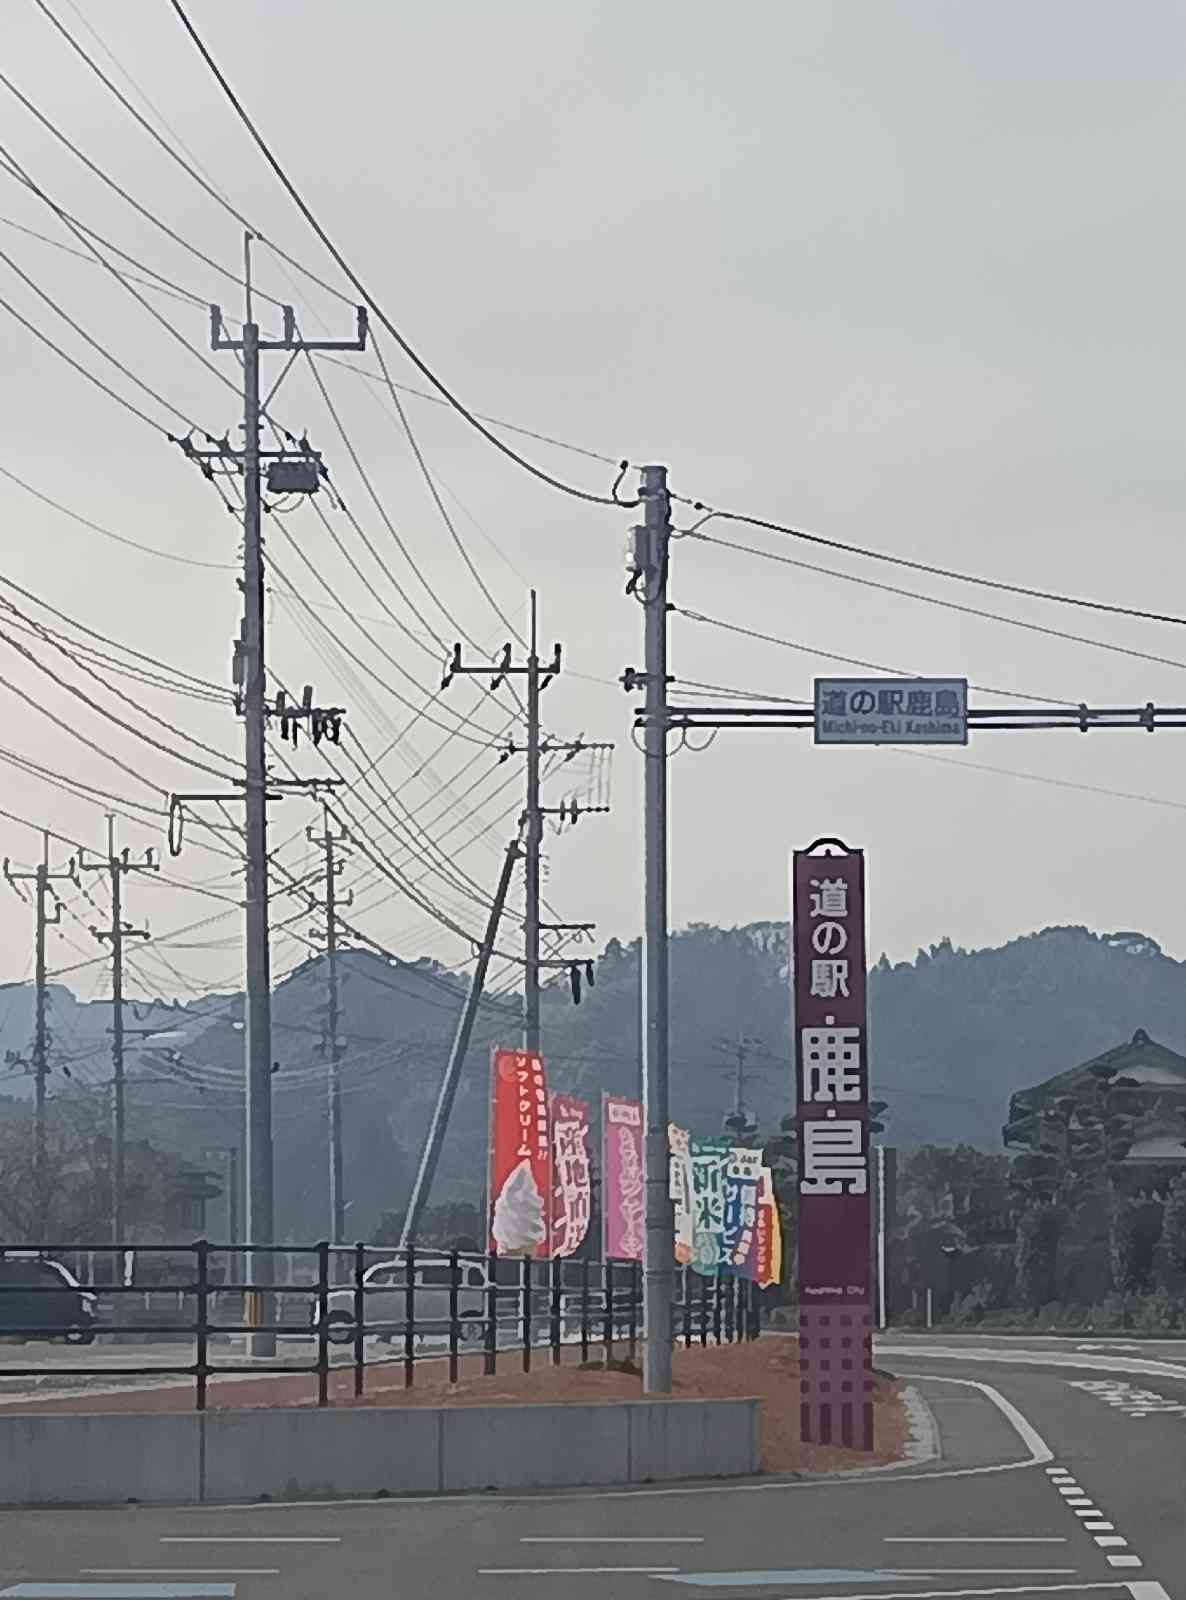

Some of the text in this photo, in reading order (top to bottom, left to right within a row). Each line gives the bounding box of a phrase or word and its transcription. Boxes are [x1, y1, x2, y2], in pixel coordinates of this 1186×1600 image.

[822, 689, 960, 718] 道の駅鹿島
[810, 877, 850, 997] 道の駅
[515, 1056, 532, 1156] ソフトクリーム
[801, 1027, 867, 1194] 鹿島
